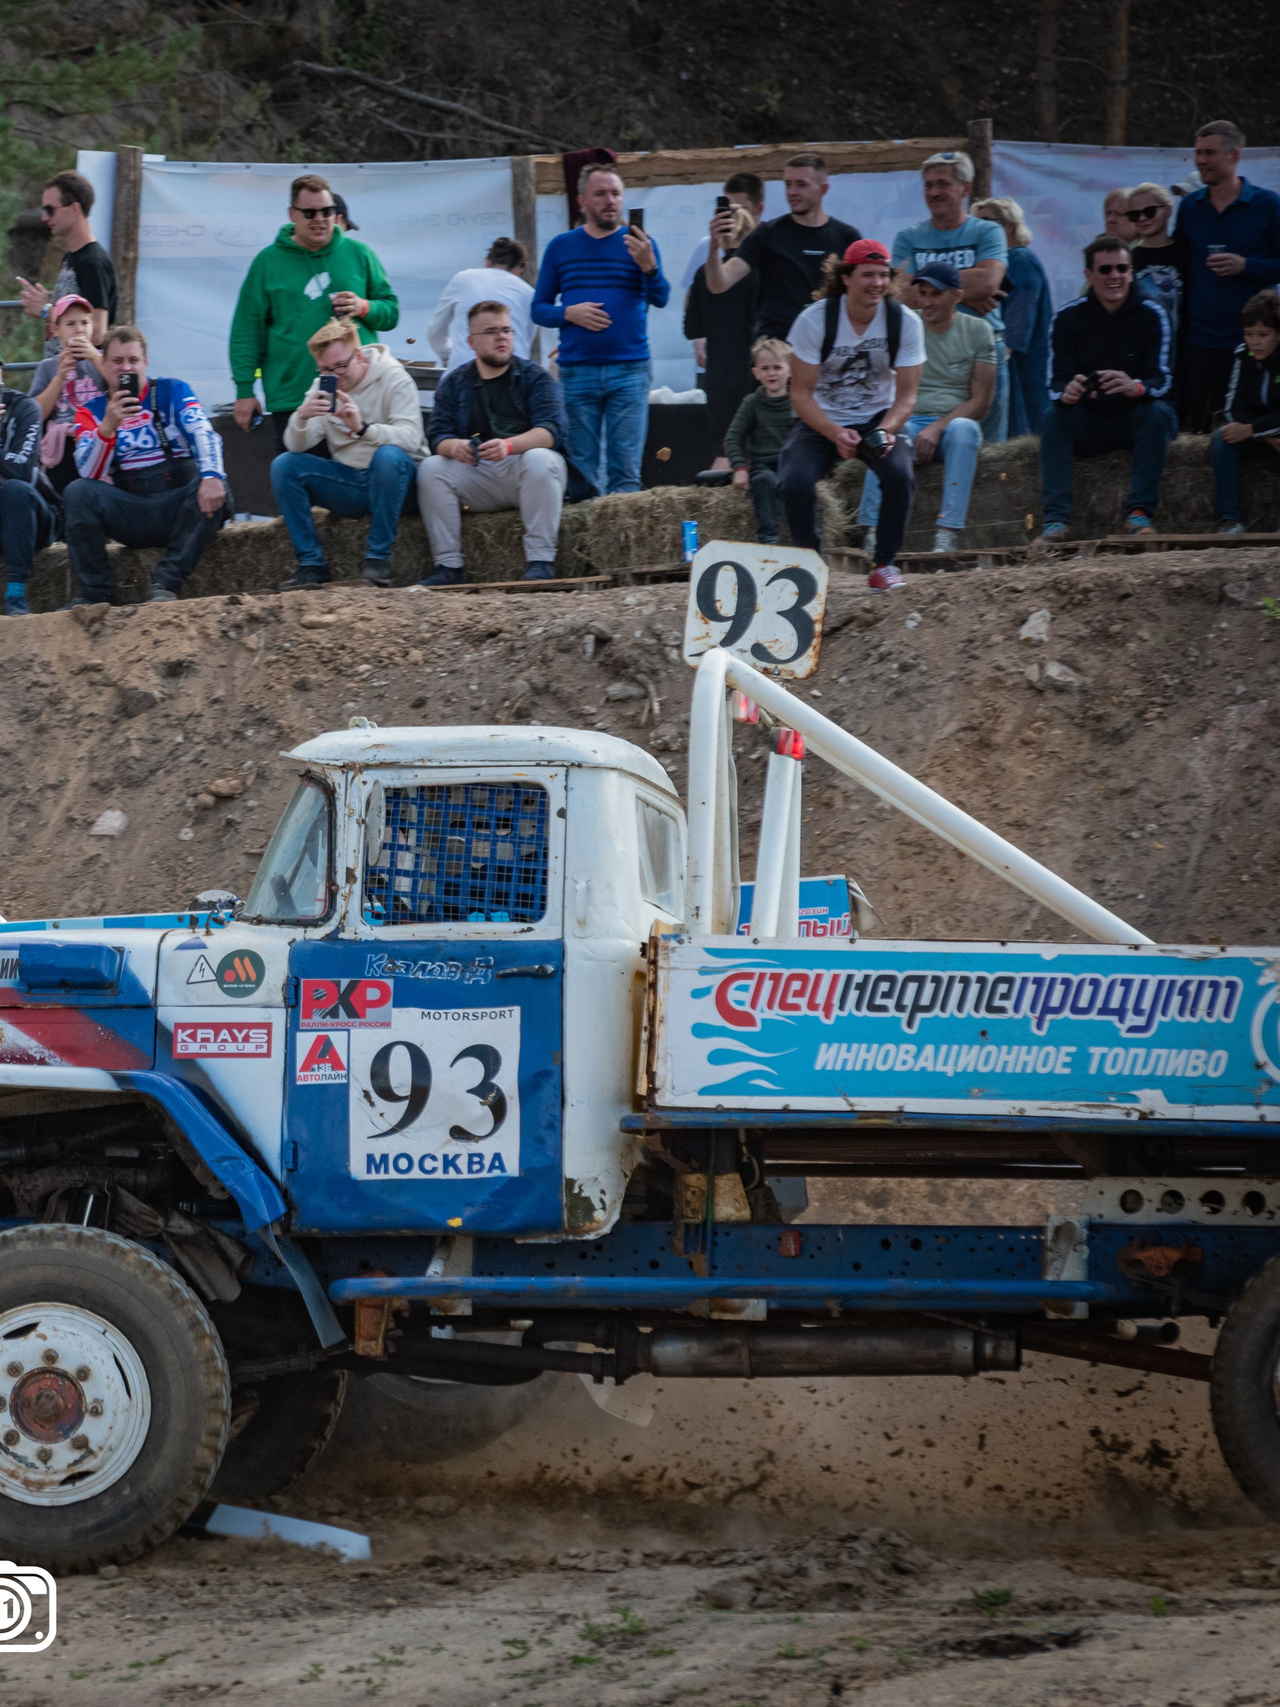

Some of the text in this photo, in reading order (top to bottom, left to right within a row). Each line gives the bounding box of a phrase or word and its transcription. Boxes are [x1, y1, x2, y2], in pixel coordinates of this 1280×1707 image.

[118, 426, 155, 451] 36
[689, 560, 819, 664] 93
[799, 906, 829, 915] газин
[421, 1009, 515, 1021] MOTORSPORT
[177, 1029, 269, 1043] KRAYS
[180, 1044, 264, 1052] GROUP
[813, 1042, 1230, 1078] ИННОВАЦИОННОЕ ТОПЛИВО
[312, 1064, 333, 1072] 136
[296, 1072, 348, 1082] АВТОЛАЙН
[367, 1040, 508, 1143] 93
[366, 1152, 508, 1176] МОСКВА
